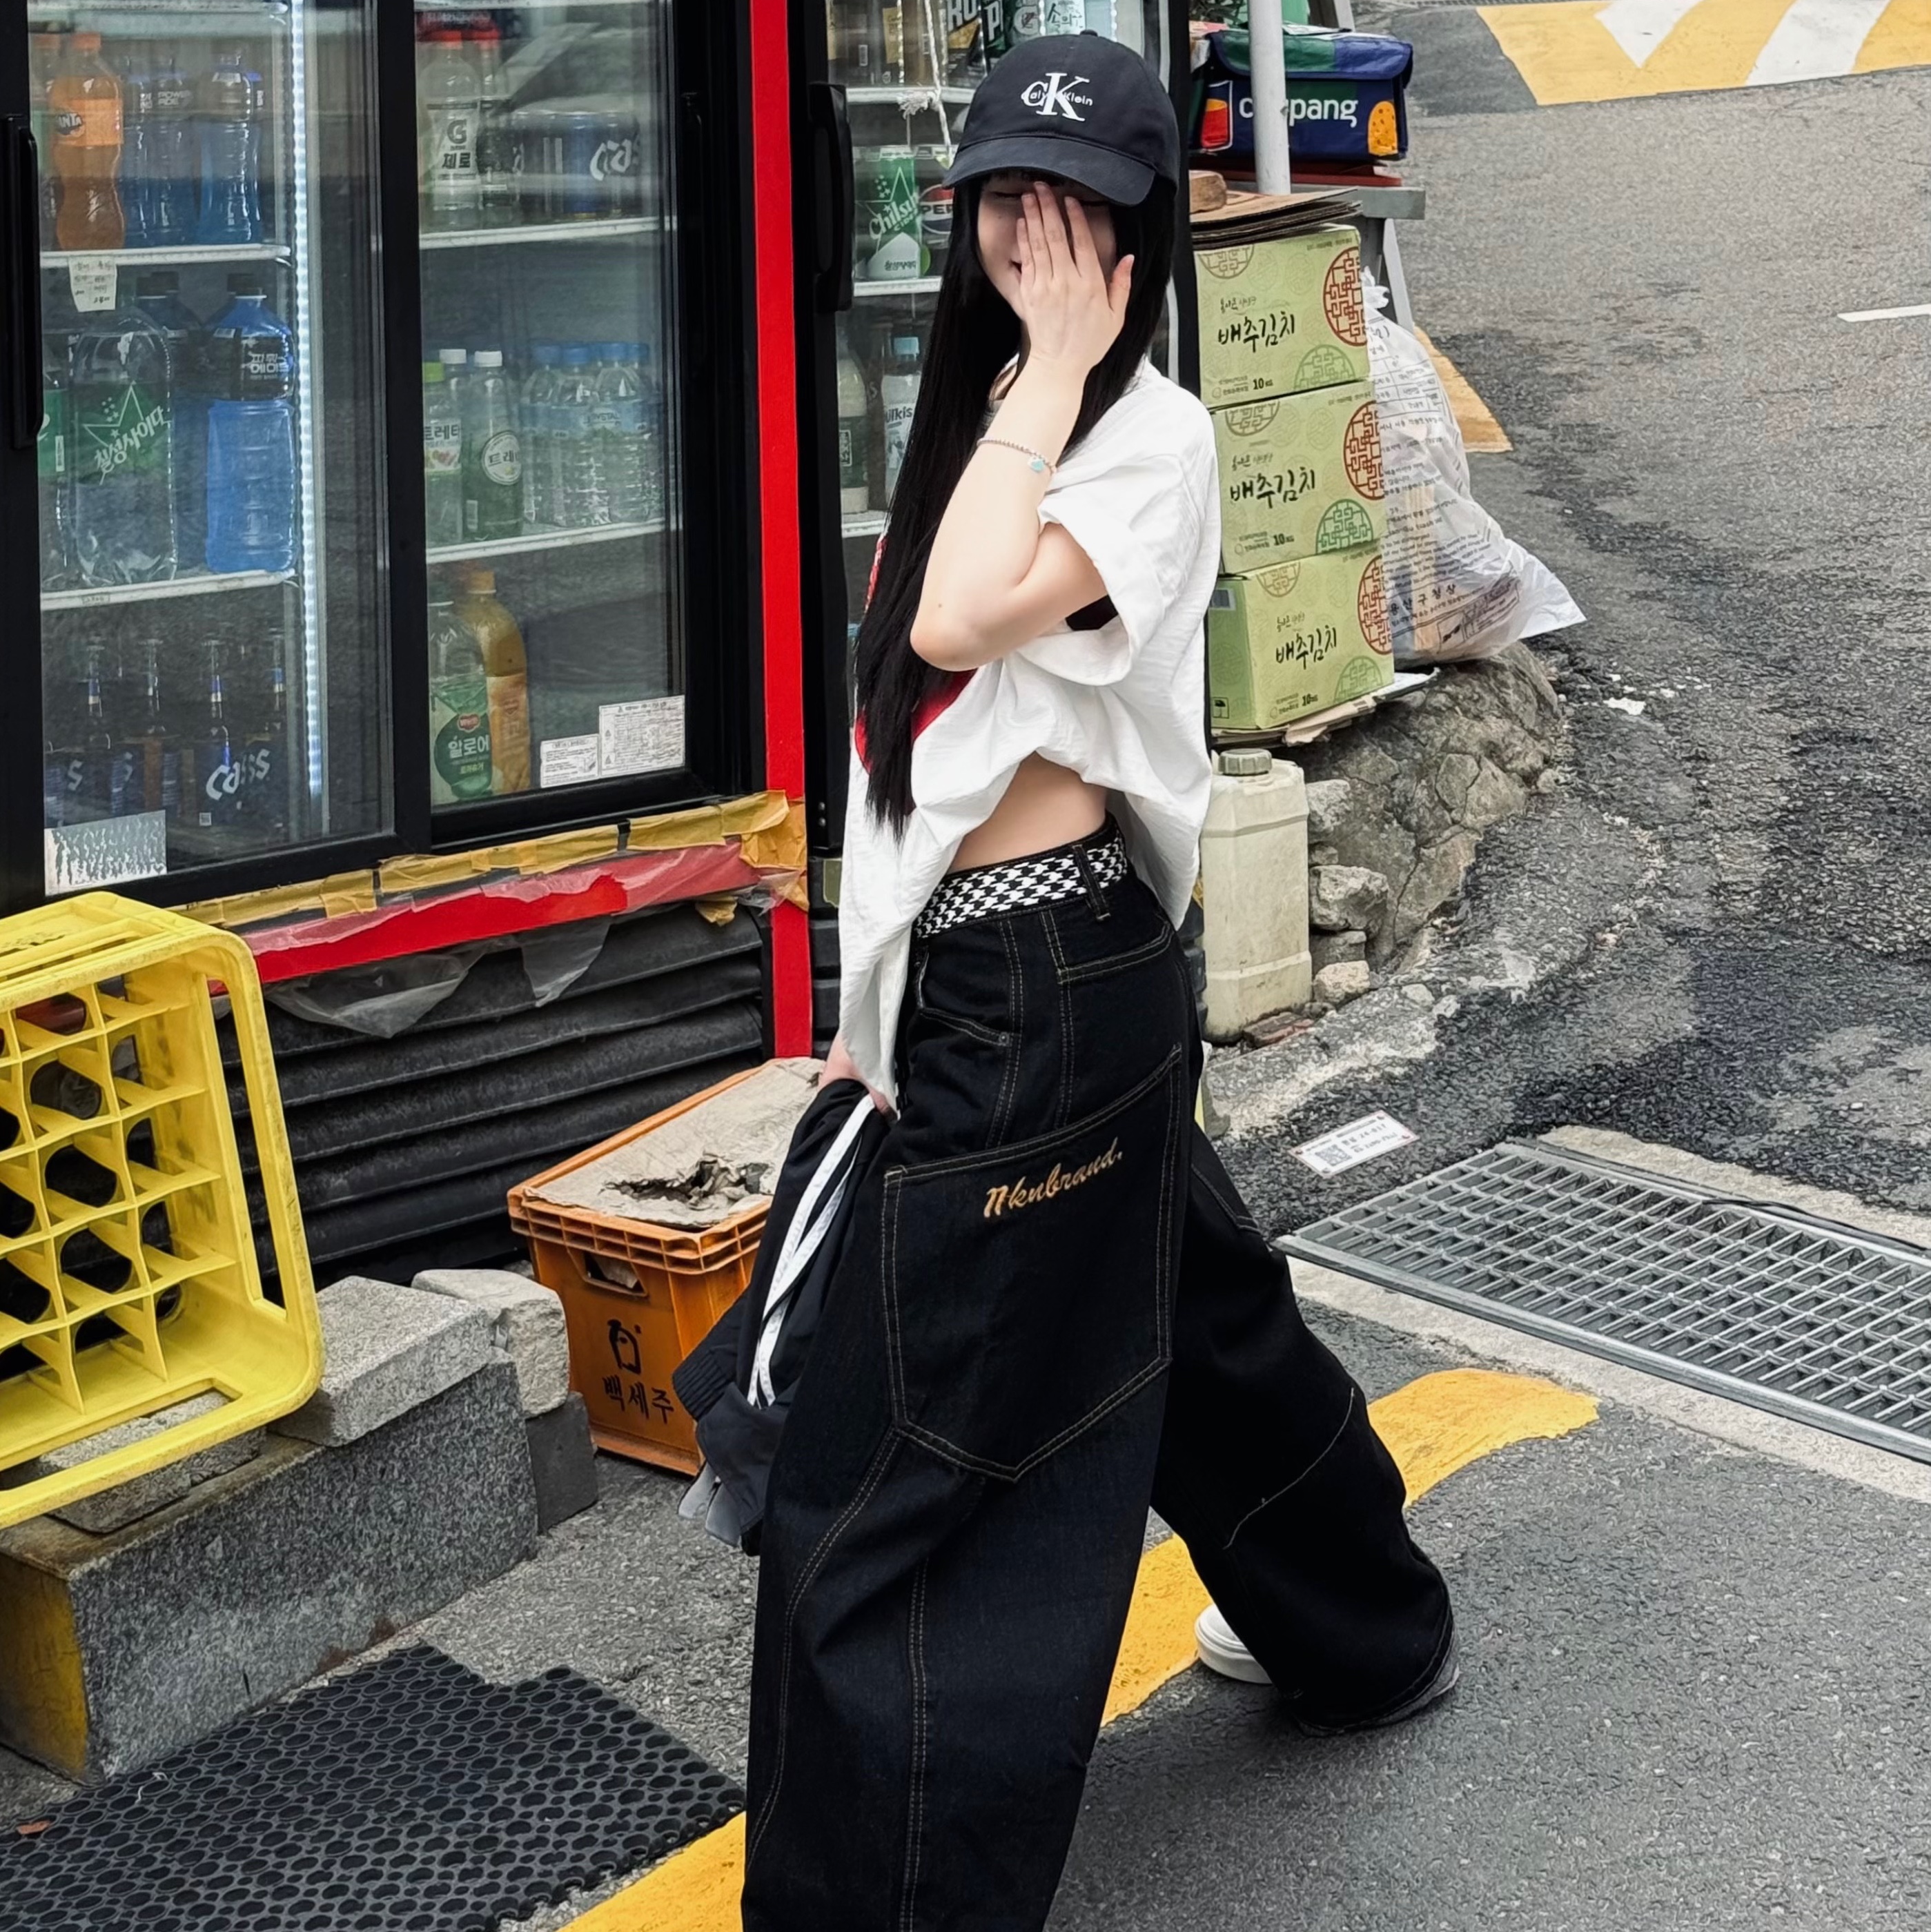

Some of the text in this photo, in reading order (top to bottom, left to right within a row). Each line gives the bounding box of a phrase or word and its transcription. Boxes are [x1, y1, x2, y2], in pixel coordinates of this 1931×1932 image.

[1239, 97, 1358, 128] cpang
[442, 152, 471, 169] 제로
[1218, 311, 1295, 353] 배추김치
[95, 405, 164, 473] 칠성사이다
[1231, 466, 1315, 509] 배추김치
[1276, 624, 1337, 670] 배추김치
[602, 1374, 674, 1425] 백세주
